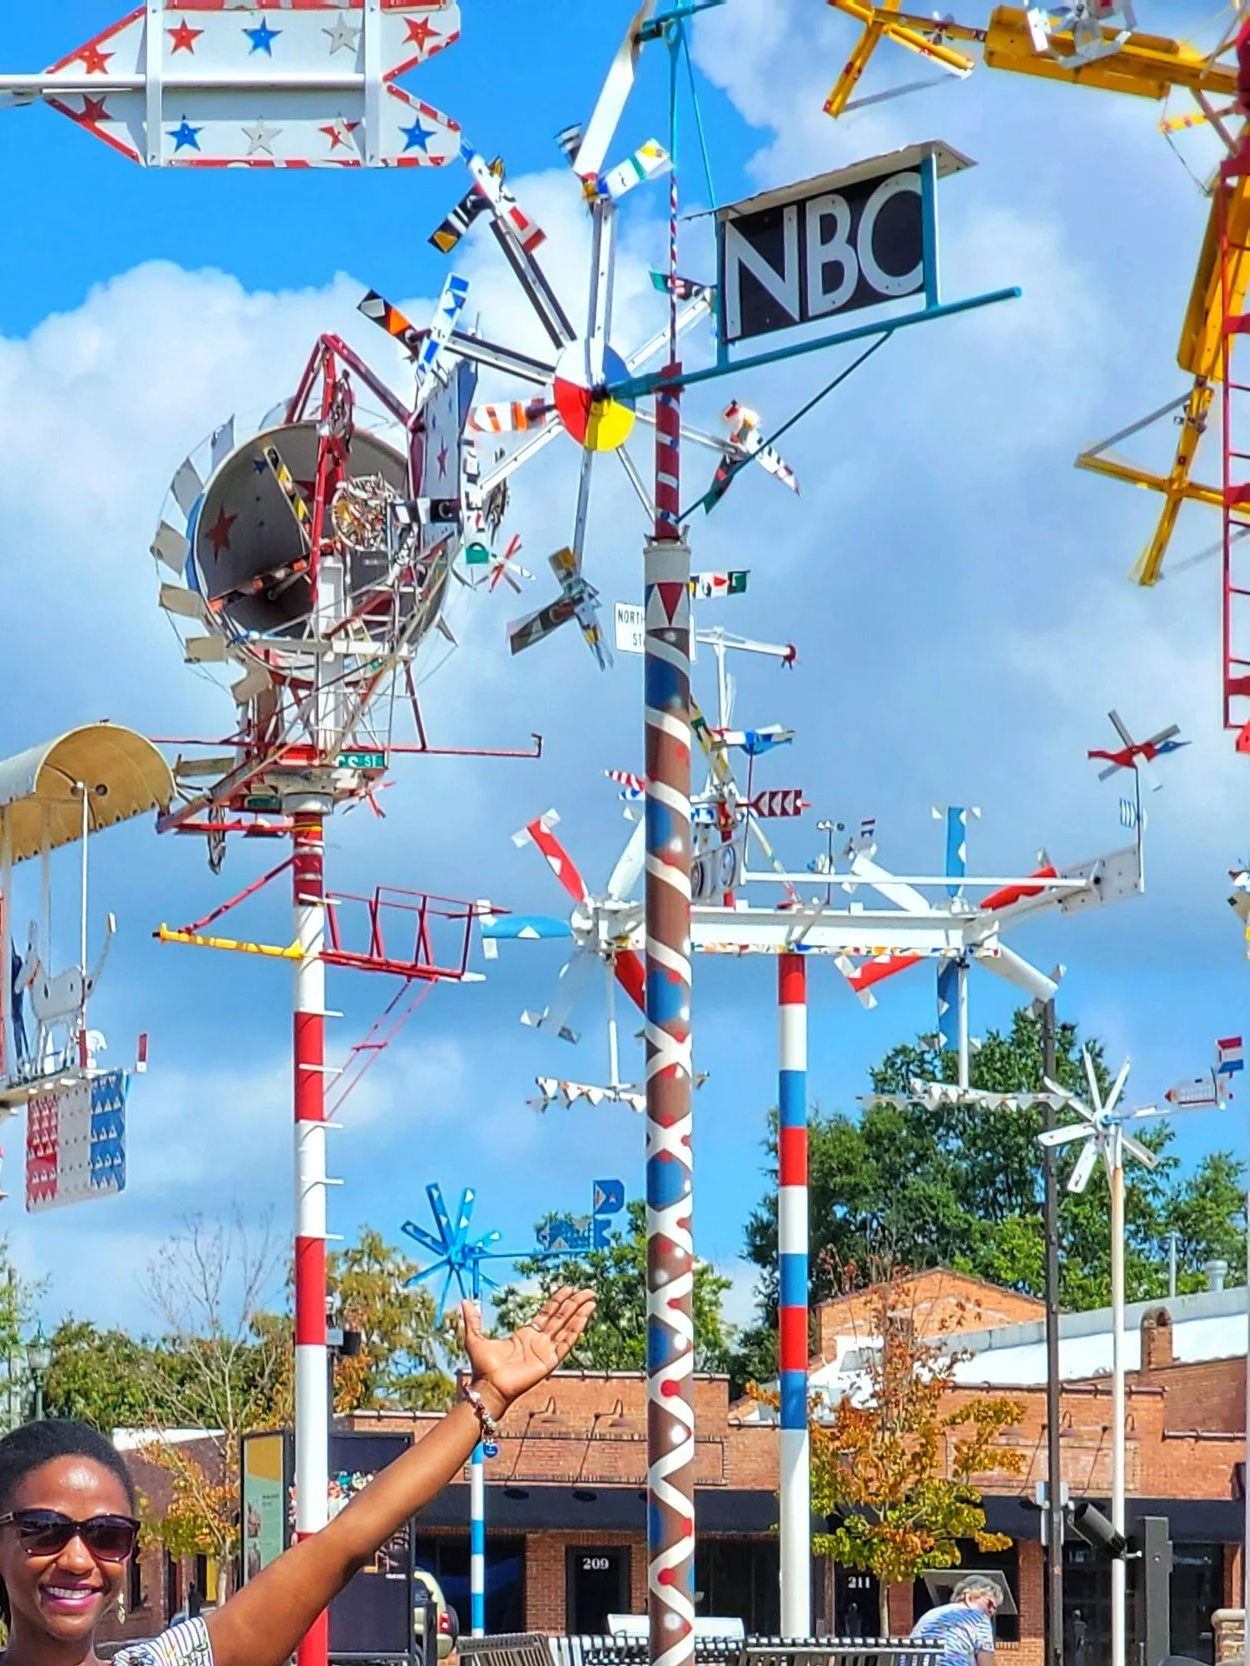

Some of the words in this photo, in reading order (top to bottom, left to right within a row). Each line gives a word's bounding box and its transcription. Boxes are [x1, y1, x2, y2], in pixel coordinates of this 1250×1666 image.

[725, 171, 924, 339] NBC
[582, 1557, 609, 1570] 209
[848, 1576, 870, 1589] 211
